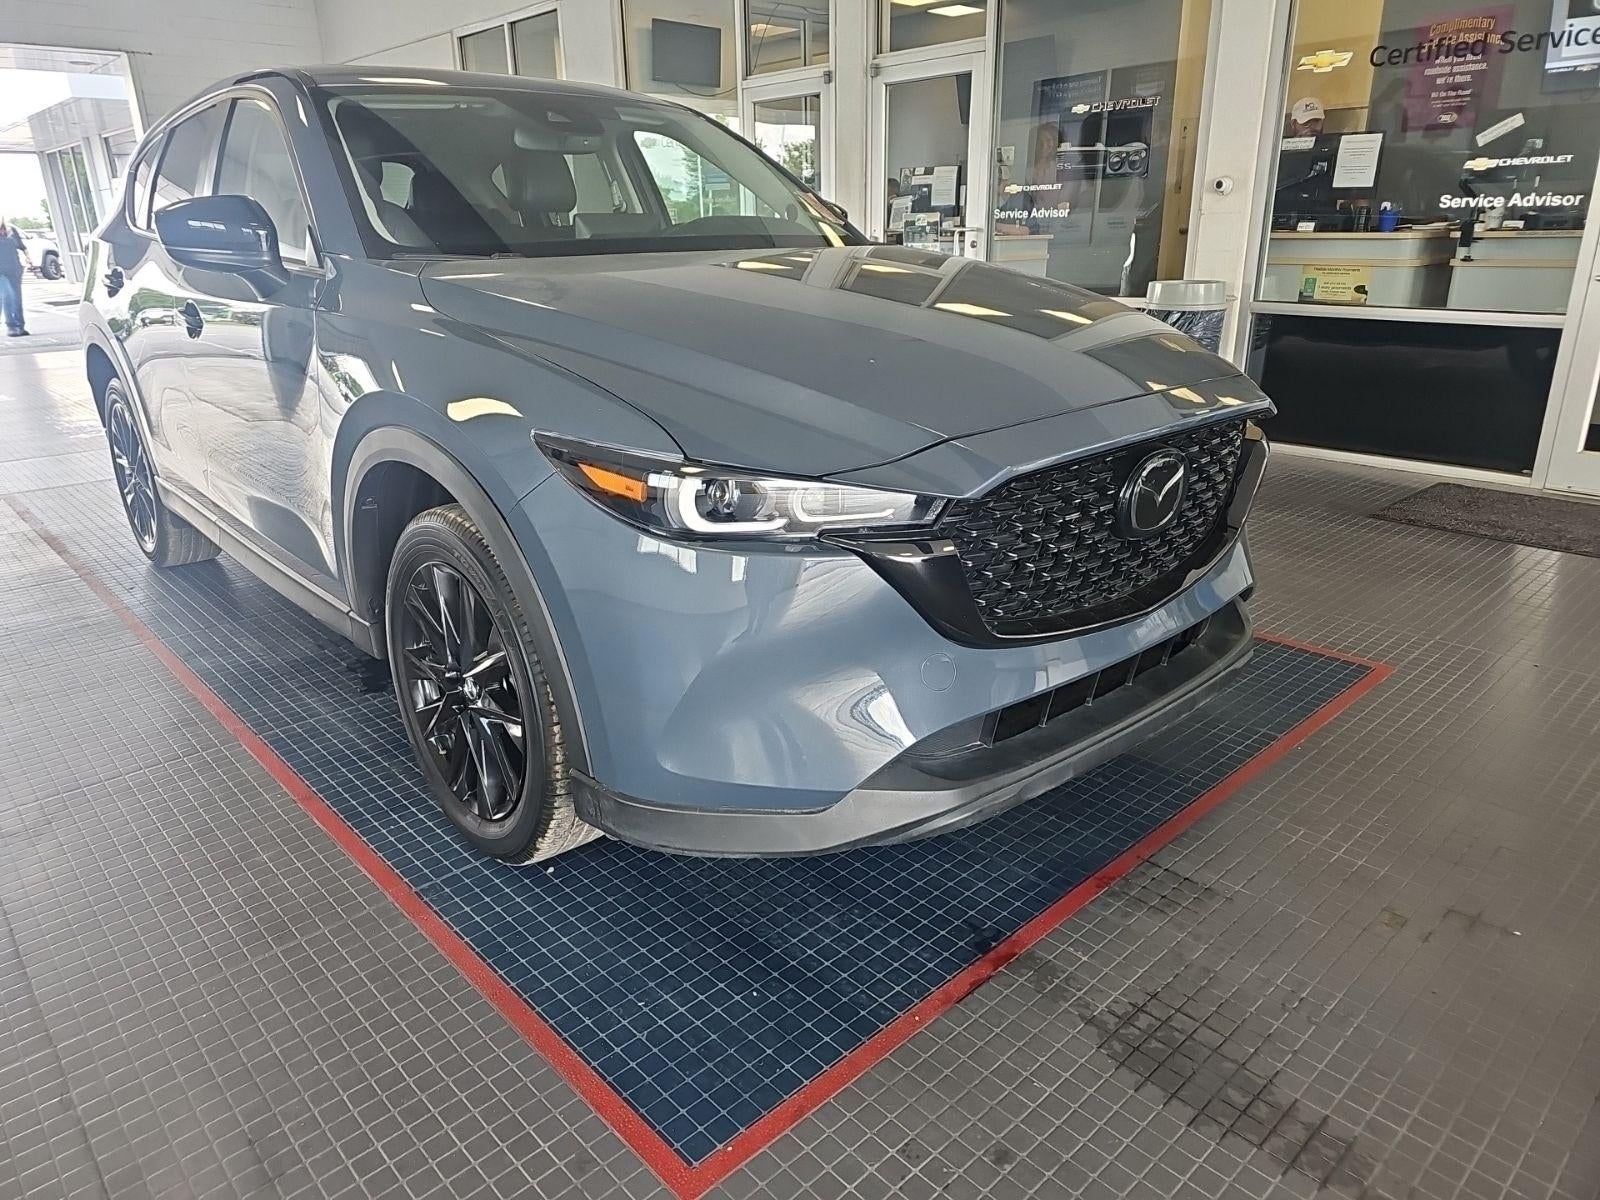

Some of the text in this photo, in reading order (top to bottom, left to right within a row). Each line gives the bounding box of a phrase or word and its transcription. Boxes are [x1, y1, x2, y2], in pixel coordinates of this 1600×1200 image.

[1429, 16, 1496, 37] Complimentary
[1370, 23, 1600, 67] Certified Service
[1091, 96, 1161, 113] CHEVROLET
[1499, 154, 1574, 166] CHEVROLET
[1023, 183, 1063, 192] CHEVROLET
[1438, 191, 1585, 209] Service Advisor
[993, 206, 1070, 219] Service Advisor
